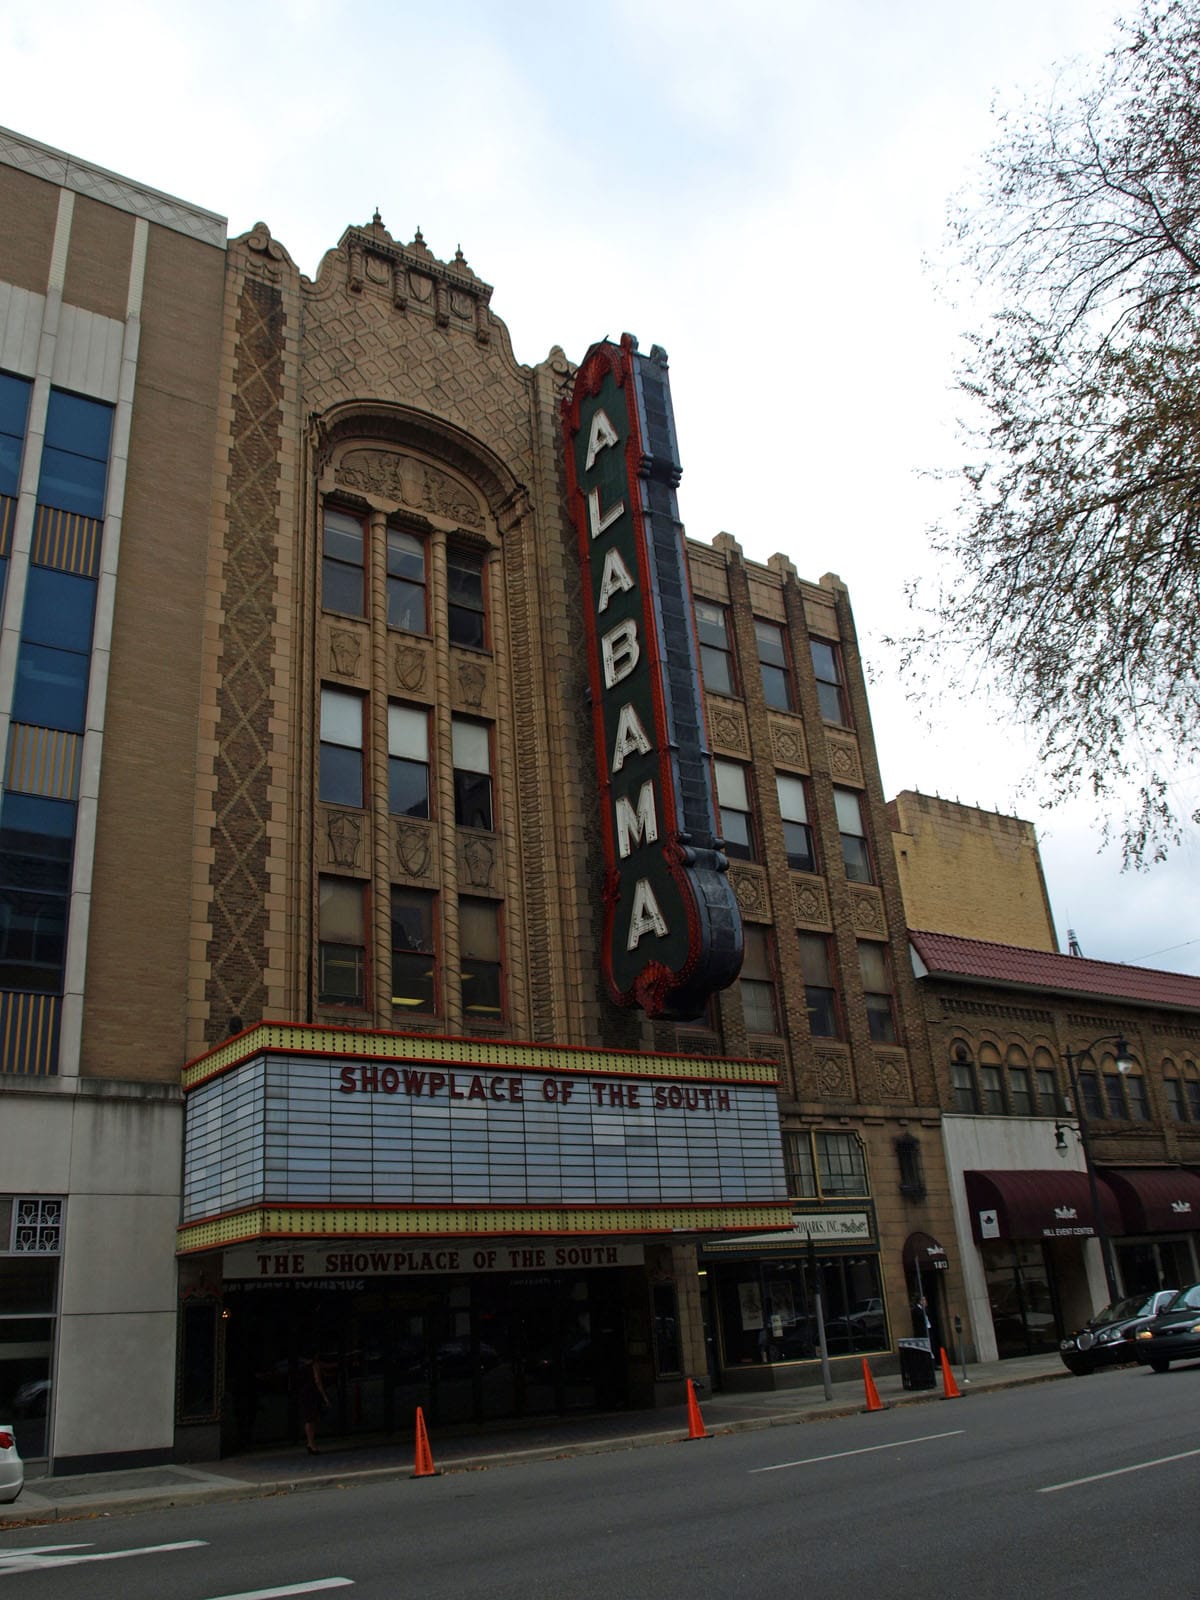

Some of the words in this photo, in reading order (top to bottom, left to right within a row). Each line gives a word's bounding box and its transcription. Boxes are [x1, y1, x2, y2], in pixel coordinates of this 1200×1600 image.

[584, 407, 668, 952] ALABAMA
[338, 1065, 525, 1103] SHOWPLACE
[542, 1078, 574, 1104] OF
[592, 1082, 640, 1109] THE
[655, 1084, 732, 1111] SOUTH
[257, 1253, 305, 1275] THE
[325, 1251, 460, 1273] SHOWPLACE
[473, 1250, 497, 1268] OF
[509, 1248, 546, 1267] THE
[555, 1247, 619, 1265] SOUTH
